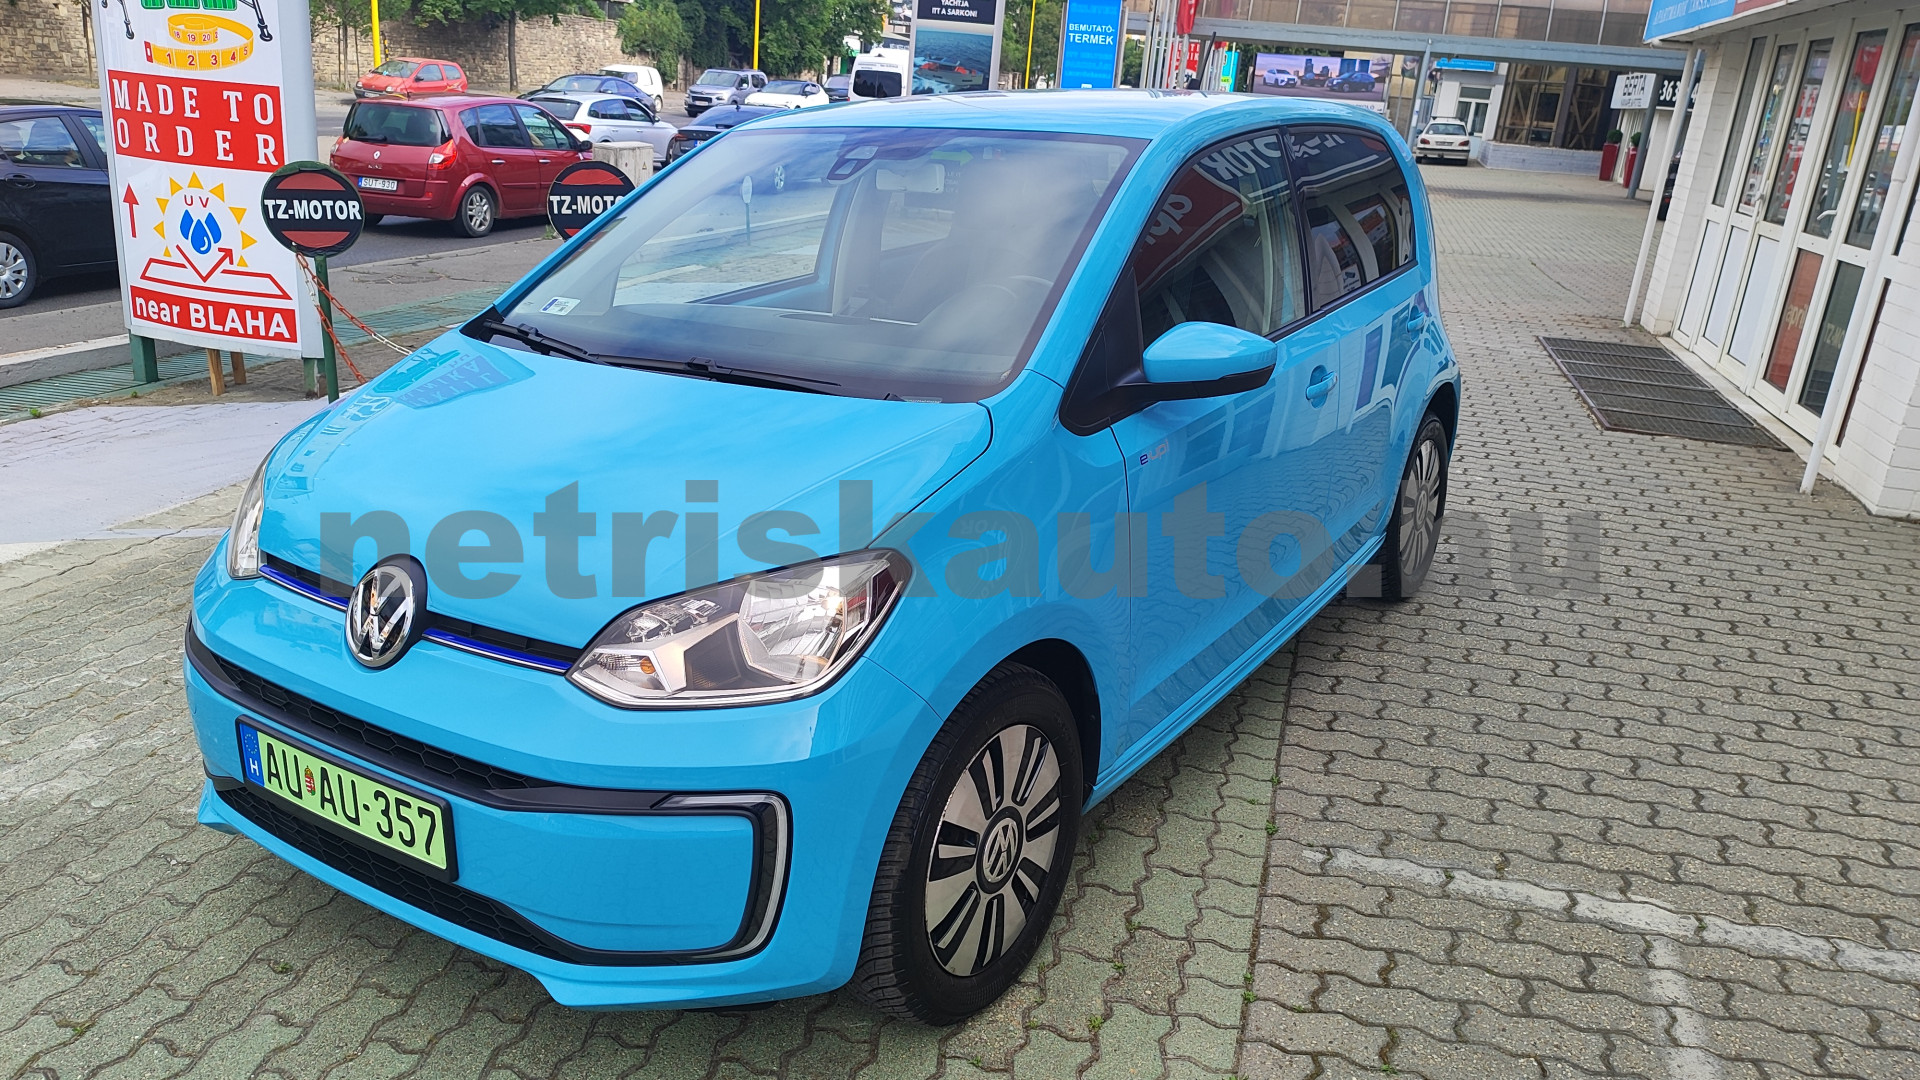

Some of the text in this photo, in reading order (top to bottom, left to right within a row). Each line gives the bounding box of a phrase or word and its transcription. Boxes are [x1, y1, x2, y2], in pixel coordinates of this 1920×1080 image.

[187, 34, 196, 42] 19
[202, 33, 211, 42] 20
[1069, 33, 1114, 45] TERMEK
[166, 46, 248, 66] 1 2 3 4 5
[112, 78, 274, 126] MADE TO
[116, 117, 279, 166] ORDER
[363, 177, 396, 190] SUT-930
[264, 199, 362, 220] TZ-MOTOR
[549, 195, 625, 215] TZ-MOT
[135, 296, 291, 339] near BLAHA
[249, 757, 260, 777] H
[266, 742, 437, 856] AU AU-357
